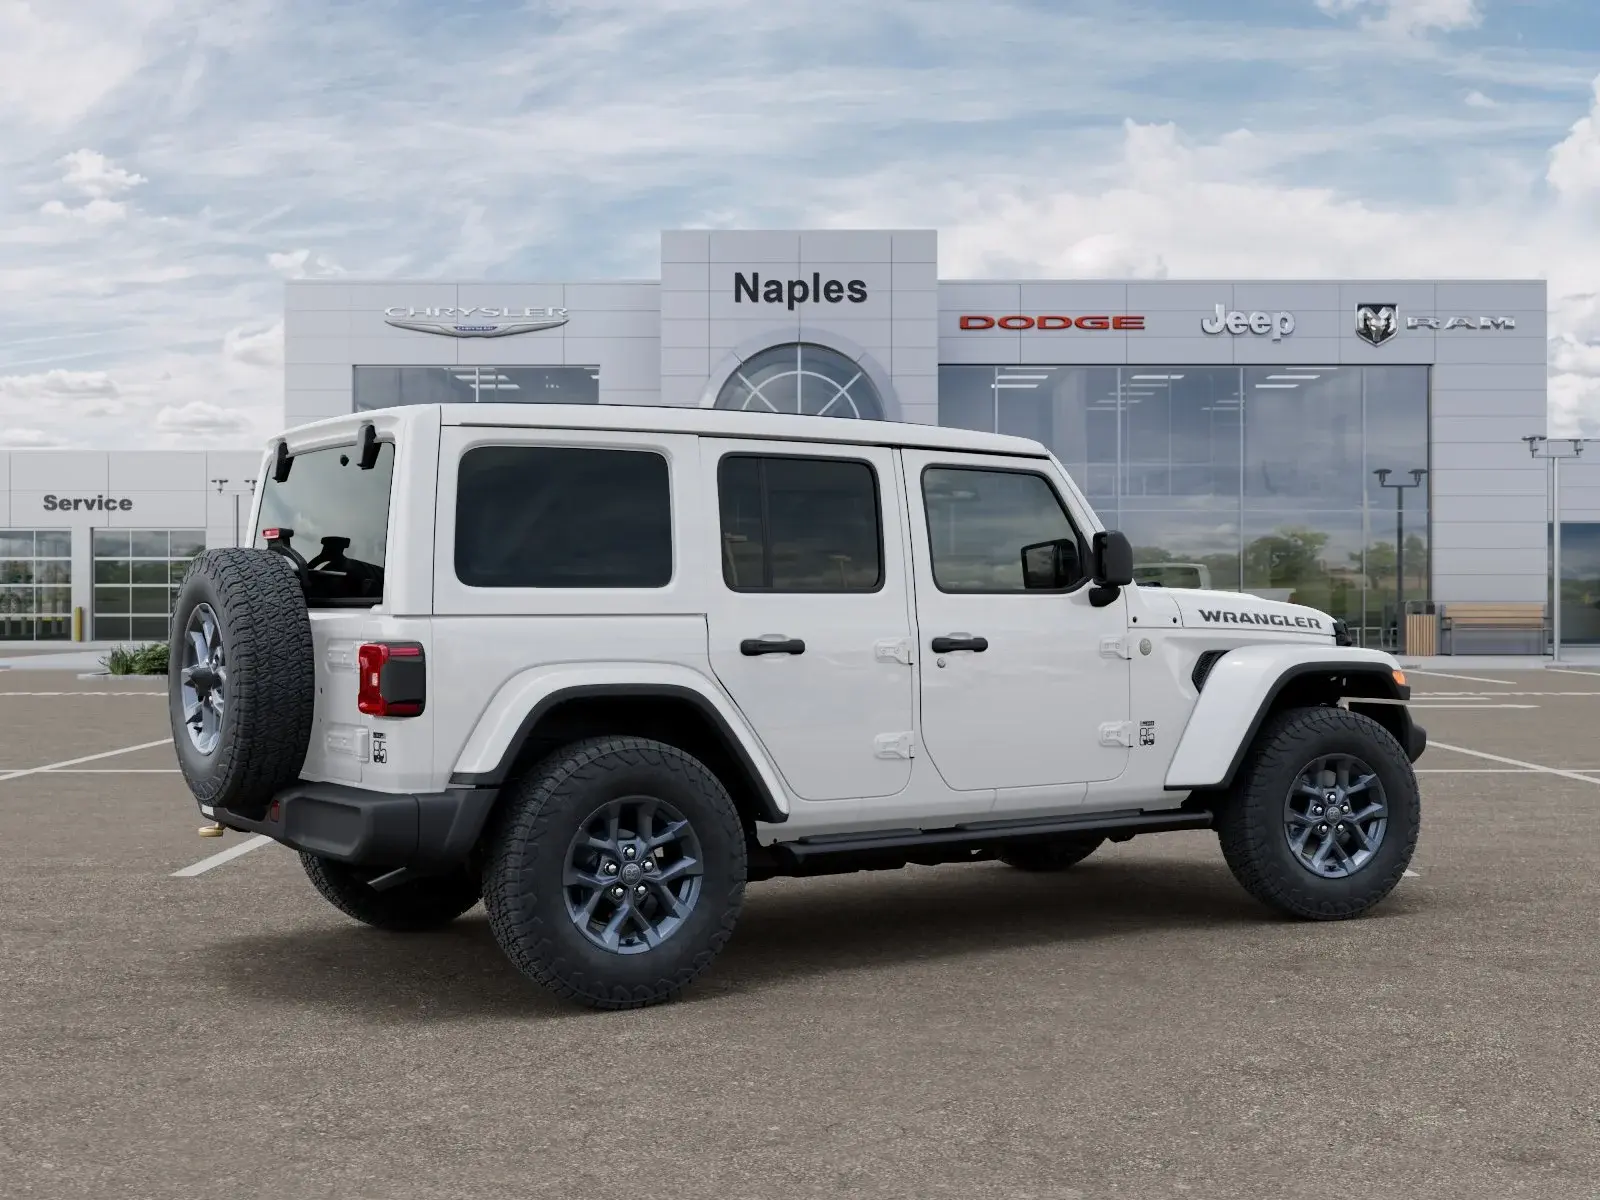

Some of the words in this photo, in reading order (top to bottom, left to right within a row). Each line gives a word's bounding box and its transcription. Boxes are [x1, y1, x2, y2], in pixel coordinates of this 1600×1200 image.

[734, 272, 868, 311] Naples
[384, 306, 568, 317] CHRYSLER
[959, 315, 1146, 330] DODGE
[1201, 303, 1295, 341] Jeep
[1406, 315, 1516, 330] RAM
[43, 494, 133, 511] Service
[1198, 609, 1322, 629] WRANGLER
